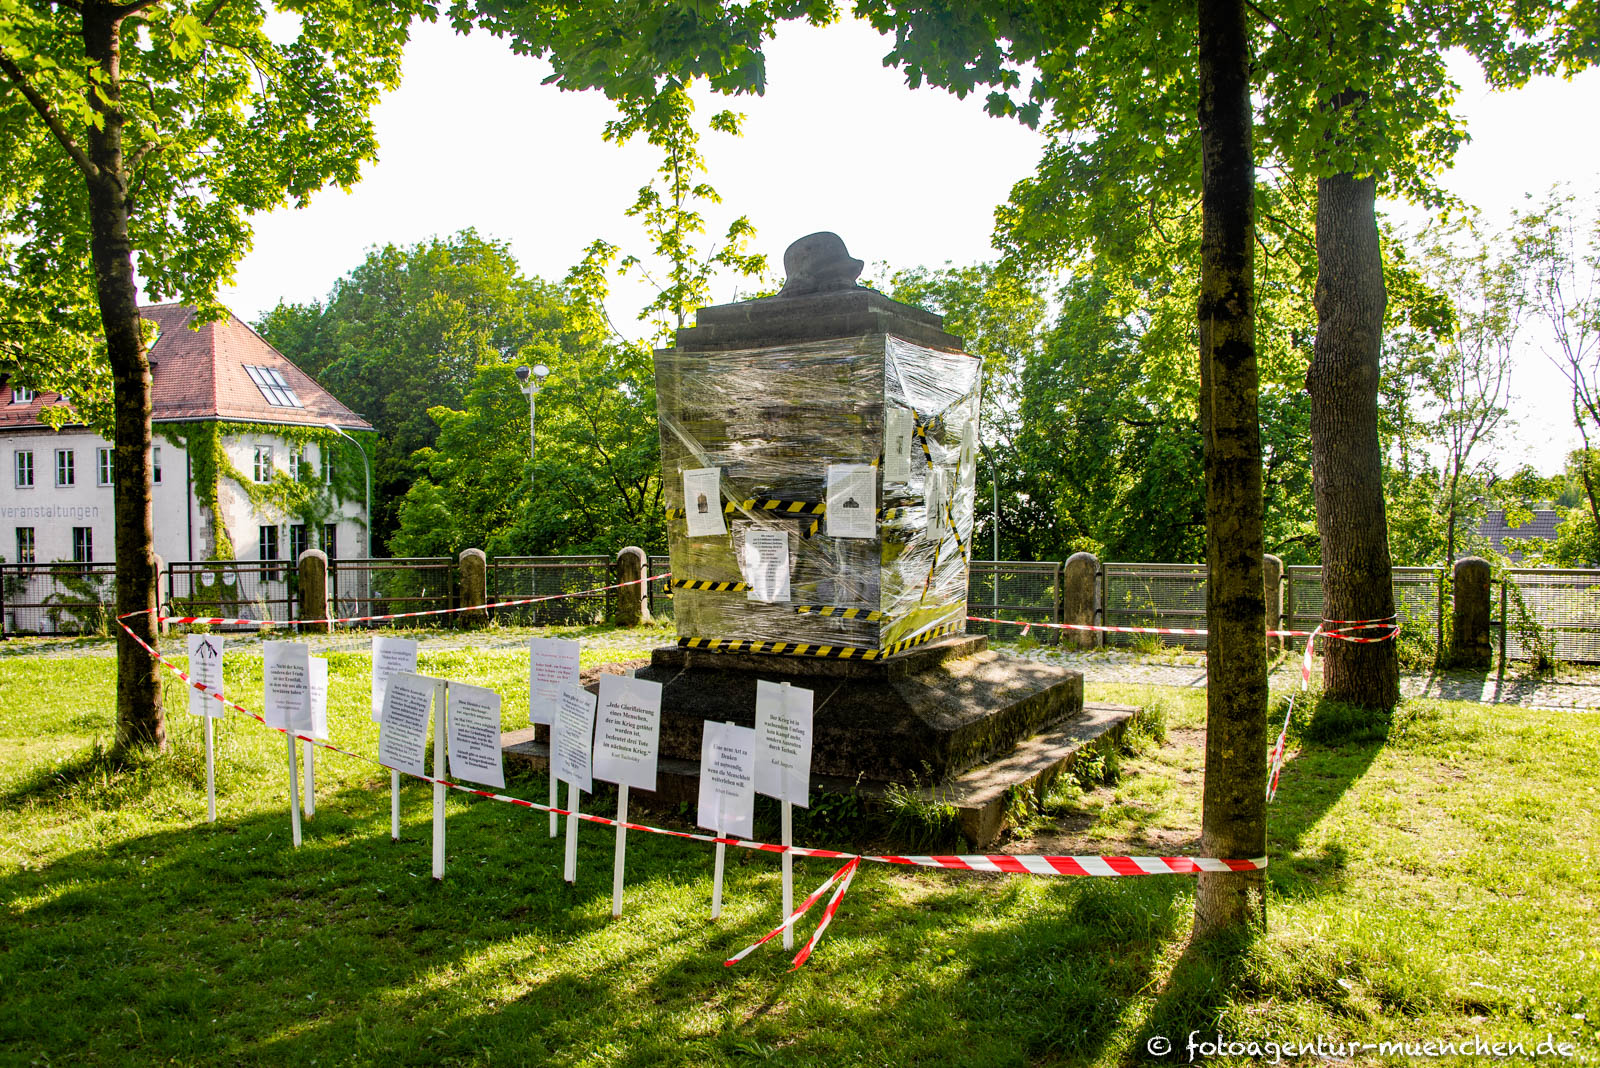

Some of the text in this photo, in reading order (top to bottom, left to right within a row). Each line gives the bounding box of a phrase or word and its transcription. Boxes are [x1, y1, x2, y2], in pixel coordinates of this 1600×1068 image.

[1, 504, 99, 520] veranstaltungen
[622, 720, 635, 729] Krieg
[605, 733, 626, 742] bedeutet
[611, 743, 631, 752] nächsten
